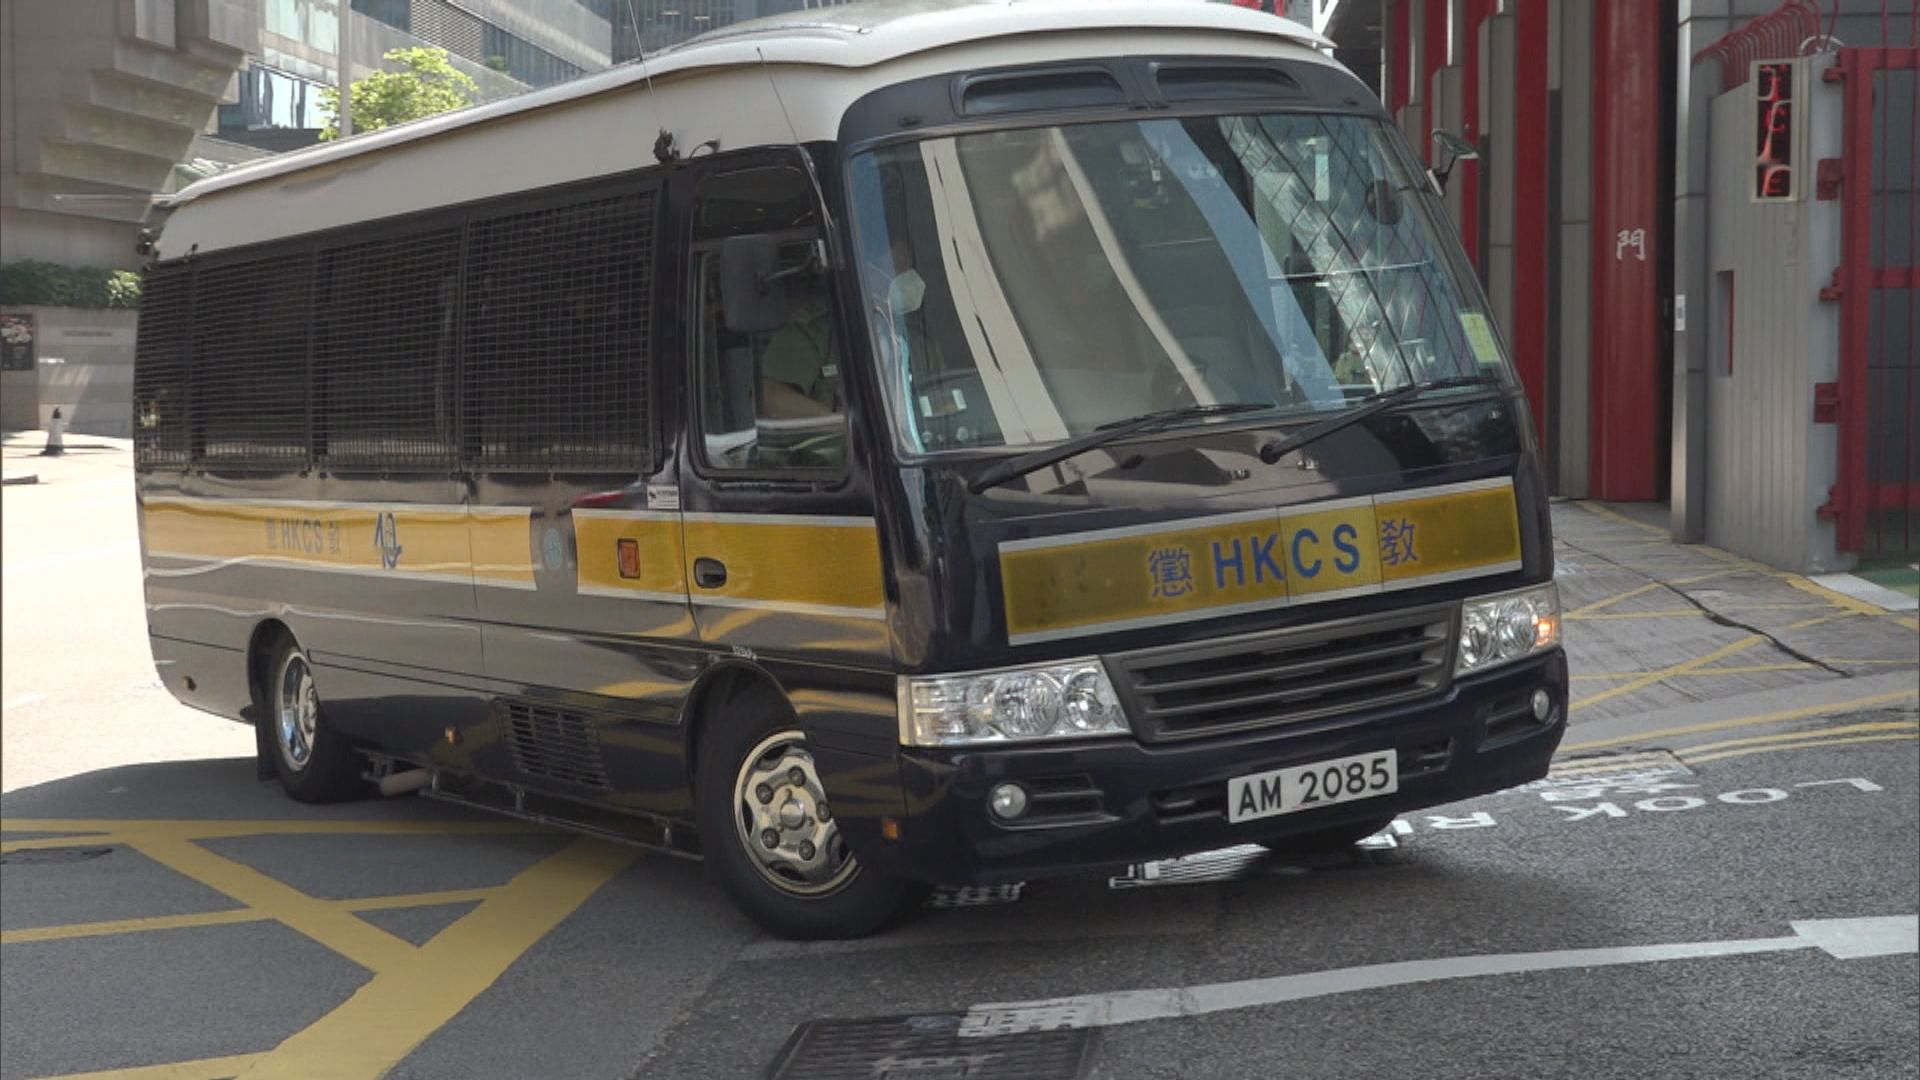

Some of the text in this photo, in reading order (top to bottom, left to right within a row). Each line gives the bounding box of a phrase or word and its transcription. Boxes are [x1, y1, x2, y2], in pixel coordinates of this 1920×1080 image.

[1616, 228, 1646, 261] 門
[281, 518, 323, 553] HKCS
[1212, 524, 1361, 588] HKCS
[1238, 758, 1389, 817] AM 2085
[1552, 777, 1885, 822] LOOK
